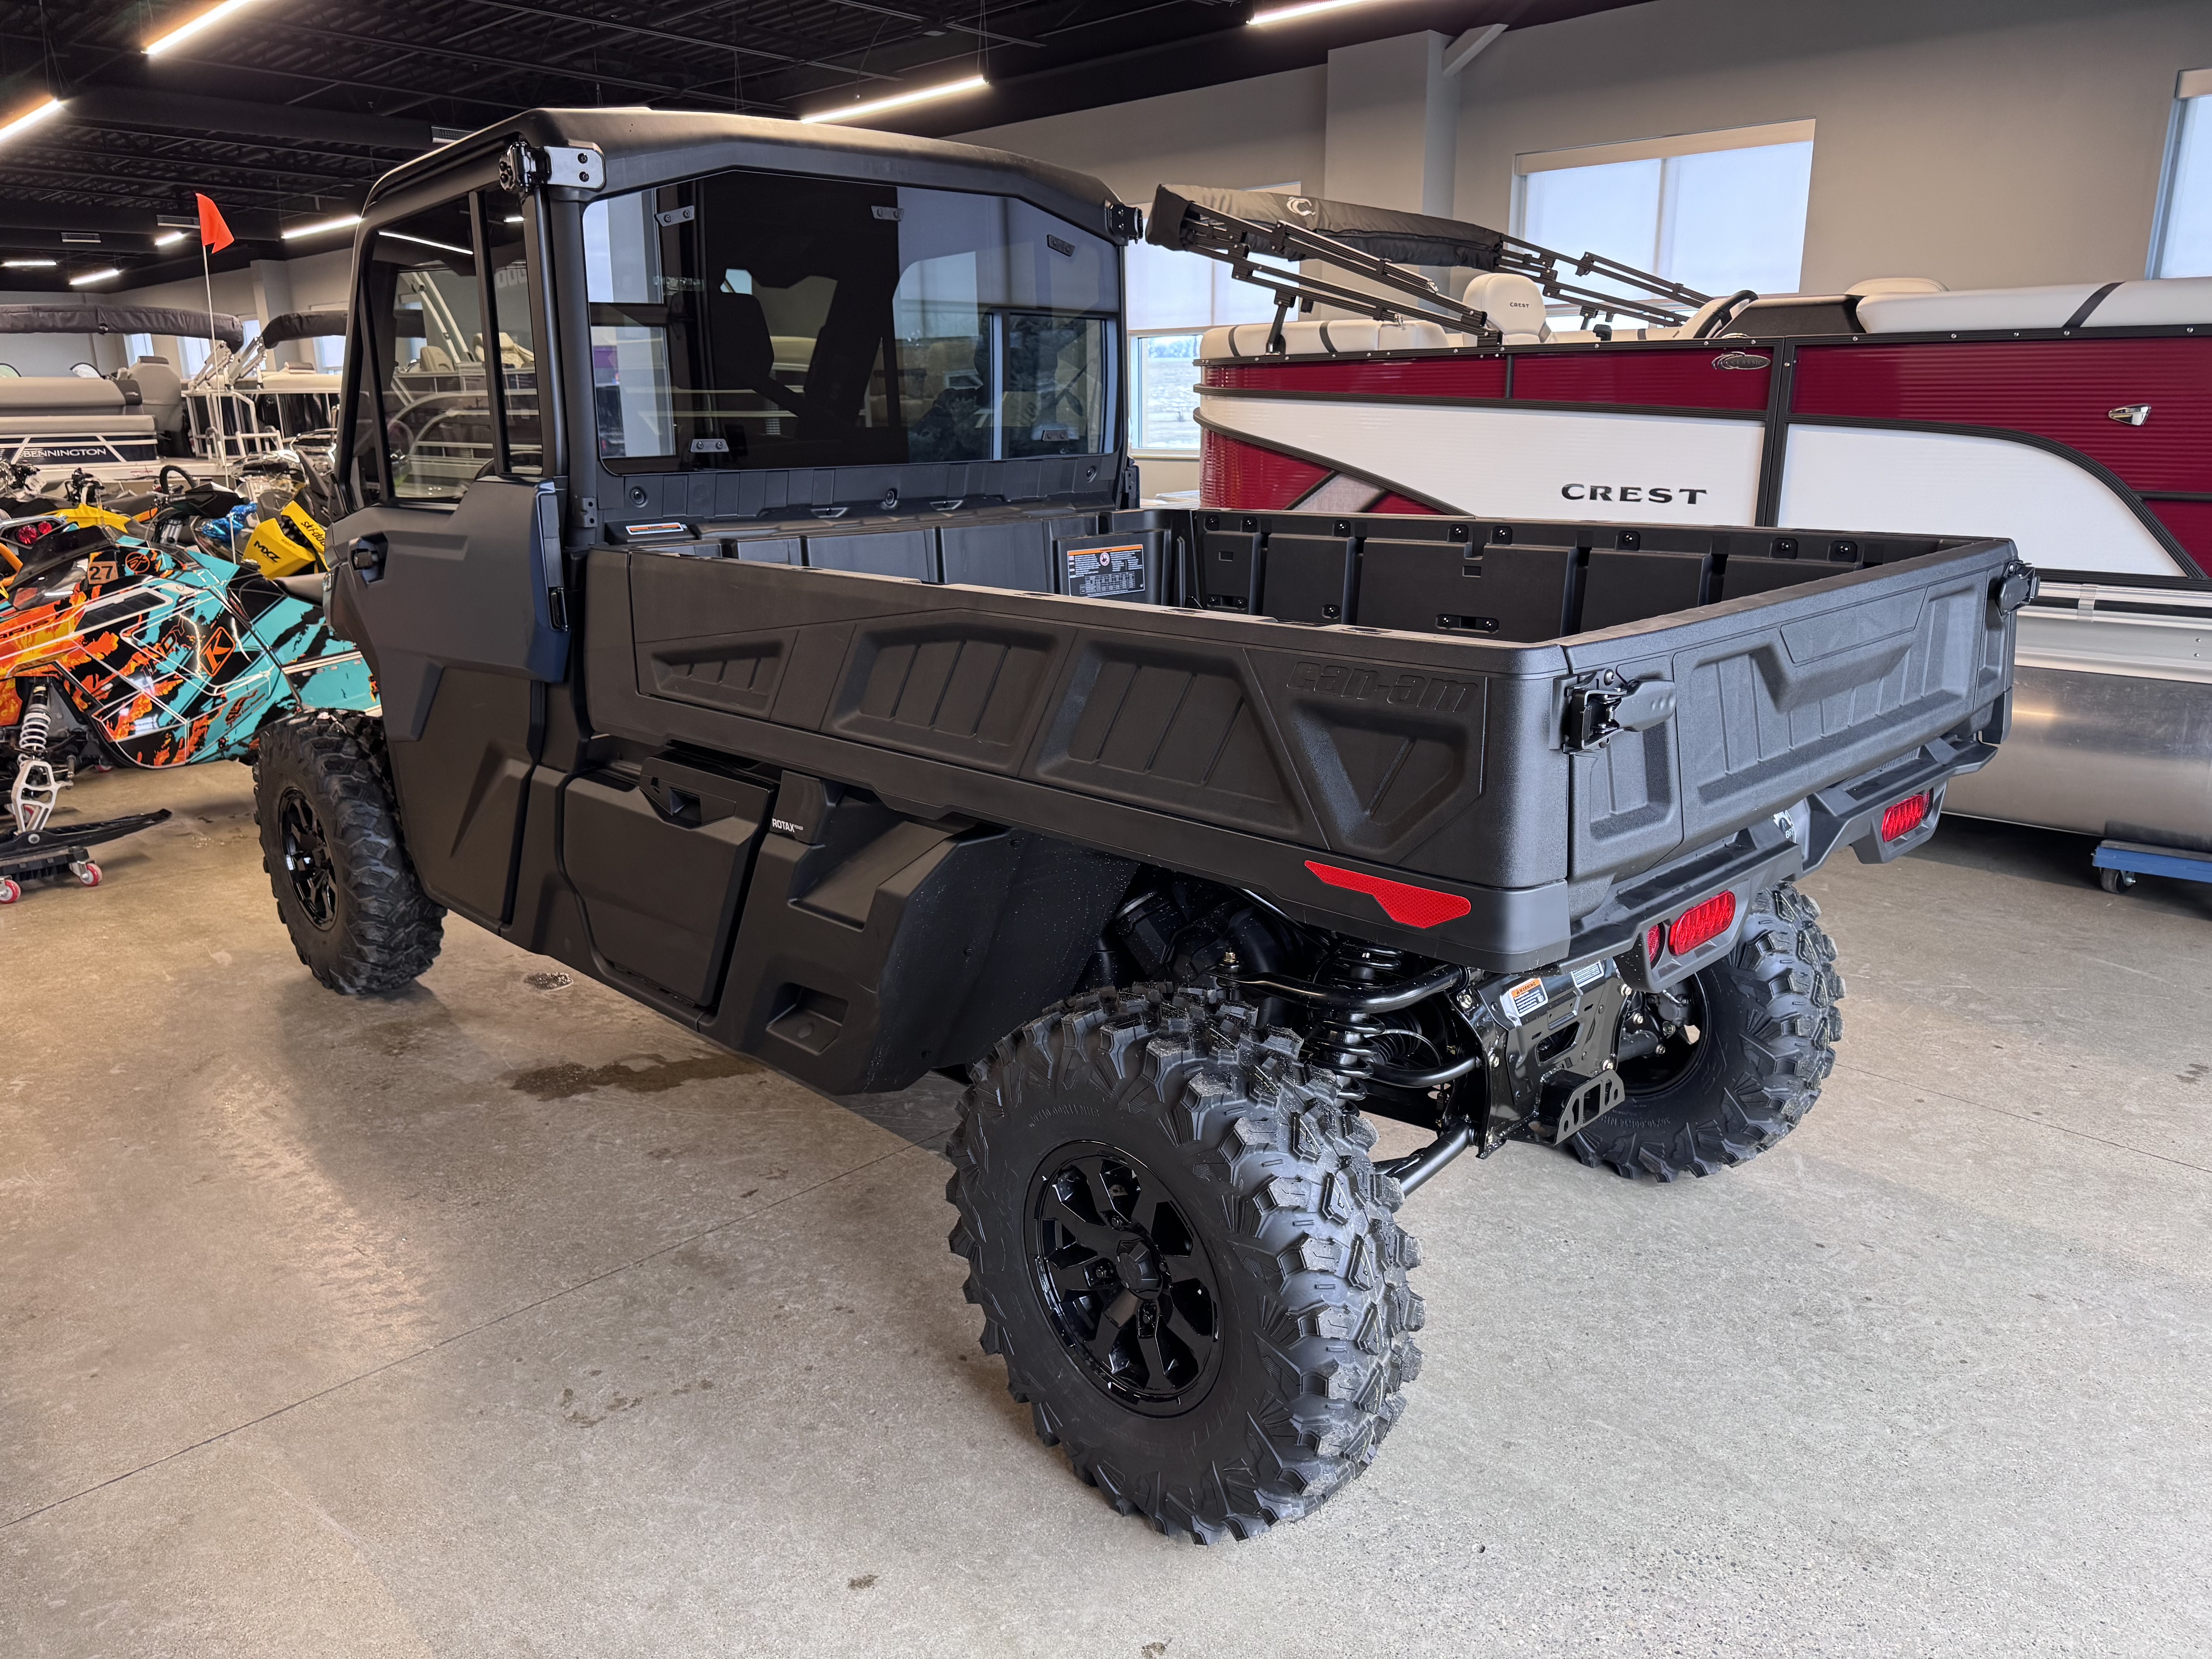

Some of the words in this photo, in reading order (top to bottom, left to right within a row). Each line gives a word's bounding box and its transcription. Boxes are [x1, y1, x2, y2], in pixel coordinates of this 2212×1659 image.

[23, 448, 106, 458] BENNINGTON
[1561, 483, 1708, 505] CREST
[254, 540, 282, 563] MXZ
[89, 565, 113, 580] 27
[1286, 661, 1479, 713] can-am
[772, 818, 795, 833] ROTAX
[1519, 981, 1536, 993] WARNING
